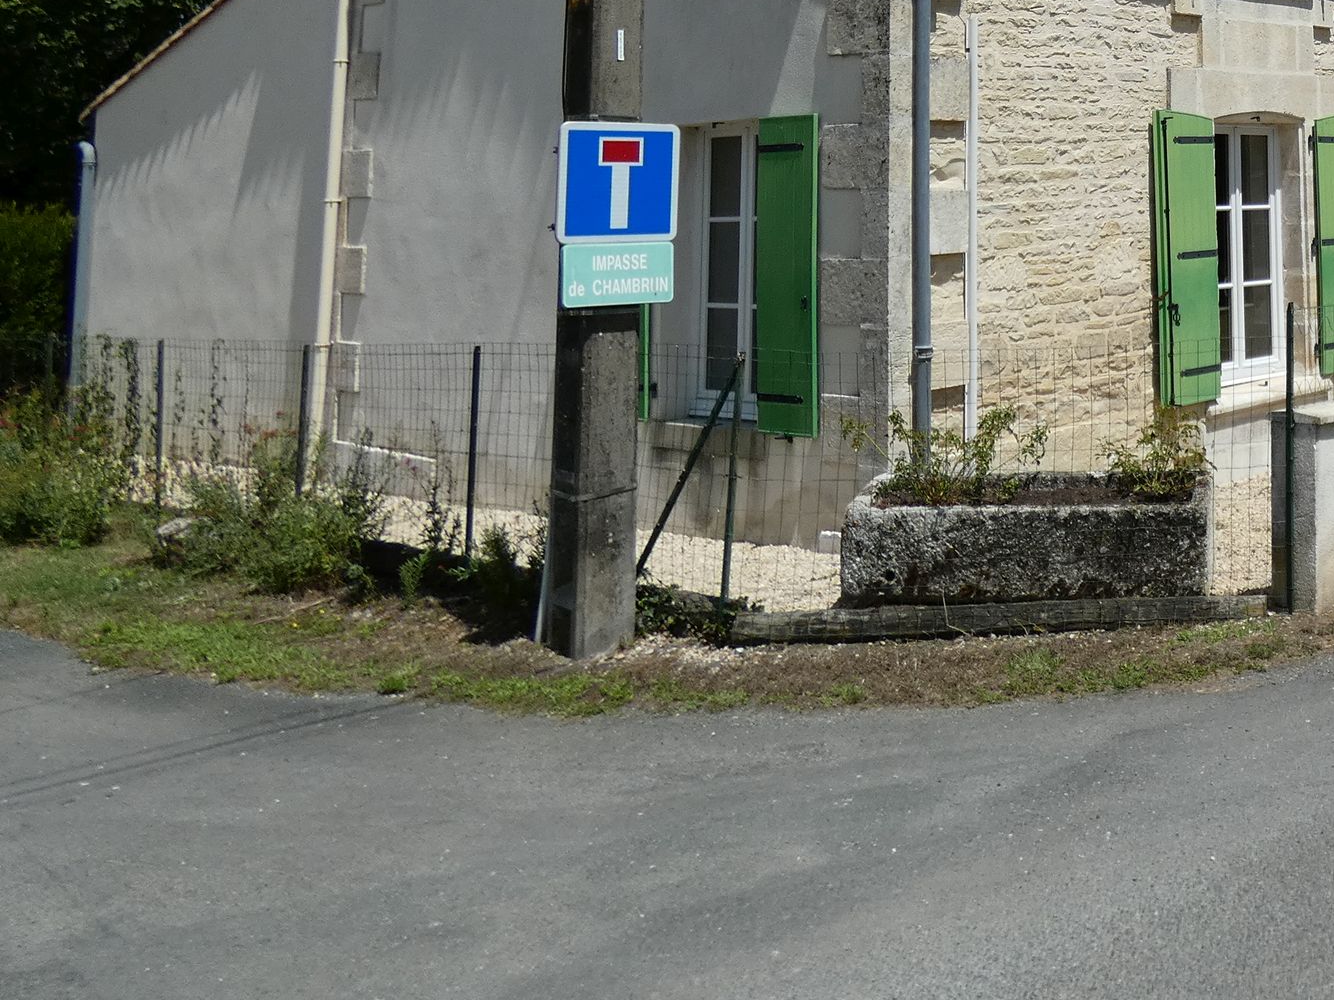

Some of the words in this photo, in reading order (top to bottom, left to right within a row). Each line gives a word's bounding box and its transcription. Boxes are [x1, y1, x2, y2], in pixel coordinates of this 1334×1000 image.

[592, 253, 648, 272] IMPASSE
[568, 280, 585, 297] de
[592, 276, 669, 297] CHAMBRUN
